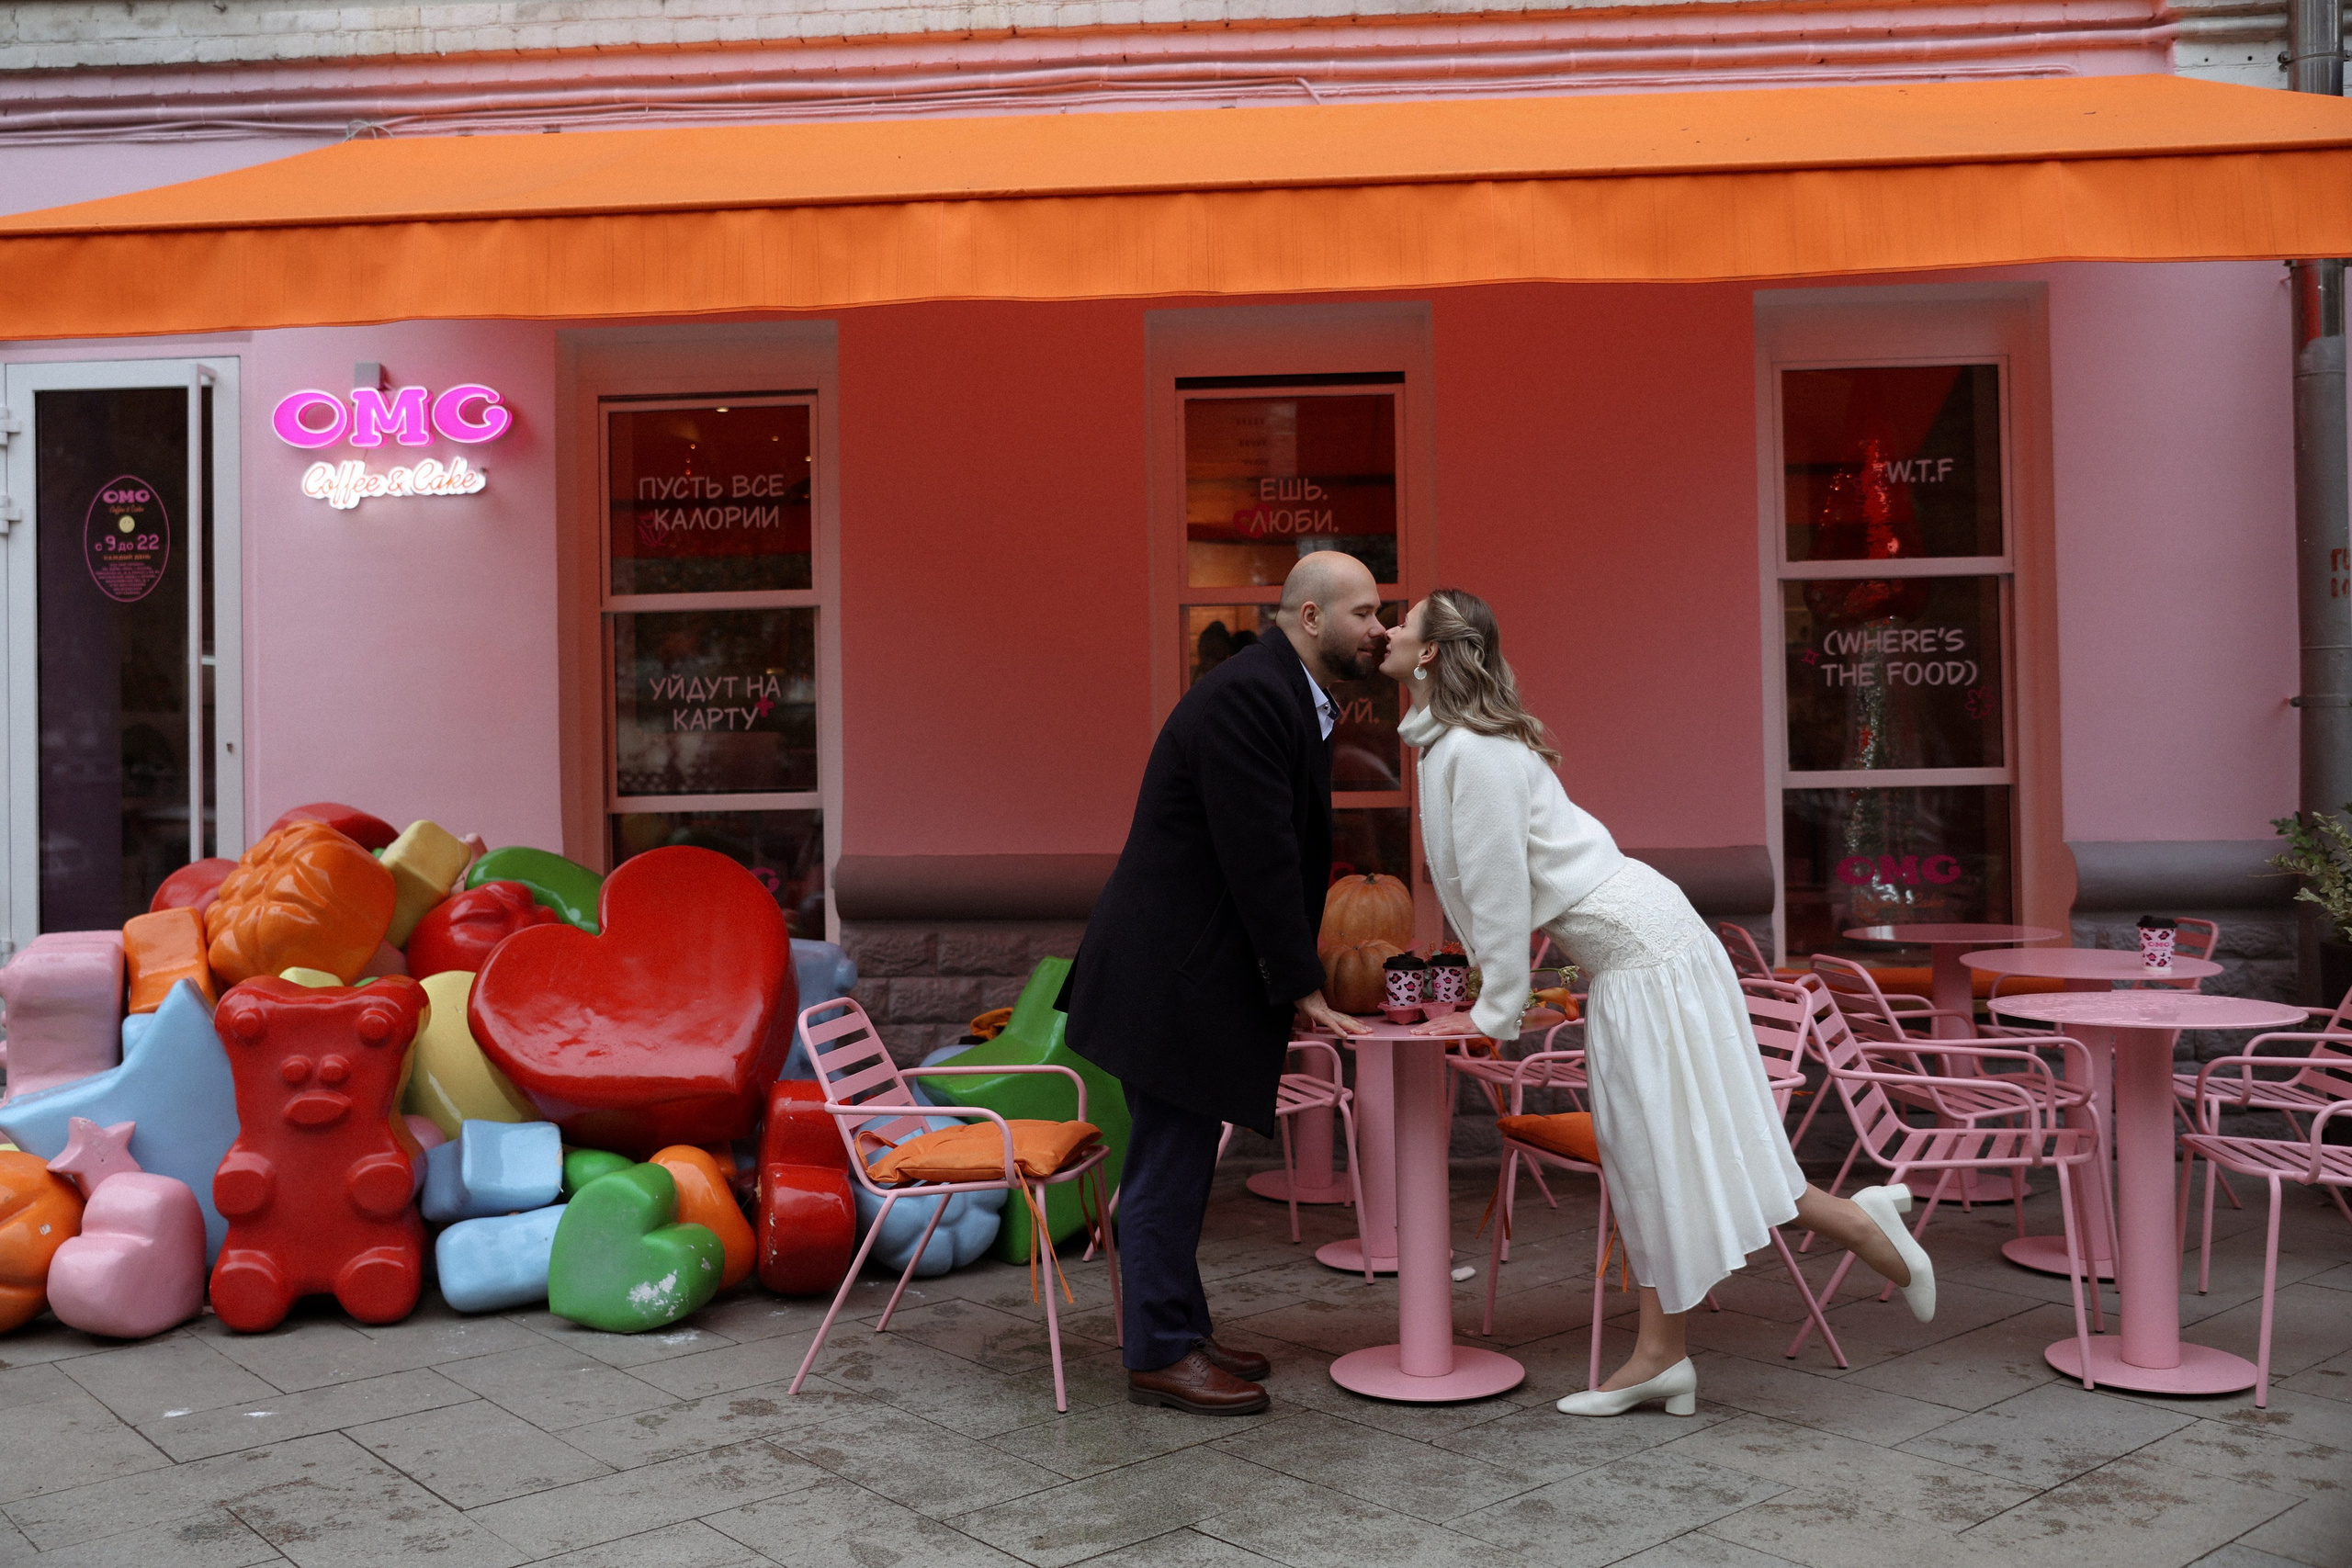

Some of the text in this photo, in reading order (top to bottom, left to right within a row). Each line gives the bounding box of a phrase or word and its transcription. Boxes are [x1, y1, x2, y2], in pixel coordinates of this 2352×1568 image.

[273, 383, 513, 449] OMG
[302, 457, 481, 509] Coffee & Cake
[1886, 458, 1954, 484] W.T.F
[638, 473, 786, 501] ПУСТЬ ВСЕ
[1260, 478, 1329, 502] ЕШЬ.
[653, 505, 781, 531] КАЛОРИИ
[1250, 509, 1340, 534] ЛЮБИ.
[105, 535, 117, 551] 9
[119, 542, 134, 552] до
[137, 534, 160, 550] 22
[1824, 626, 1965, 656] (WHERE'S
[1820, 660, 1978, 687] THE FOOD)
[649, 673, 782, 703] УЙДУТ НА
[673, 707, 760, 732] КАРТУ
[1837, 854, 1962, 886] OMG
